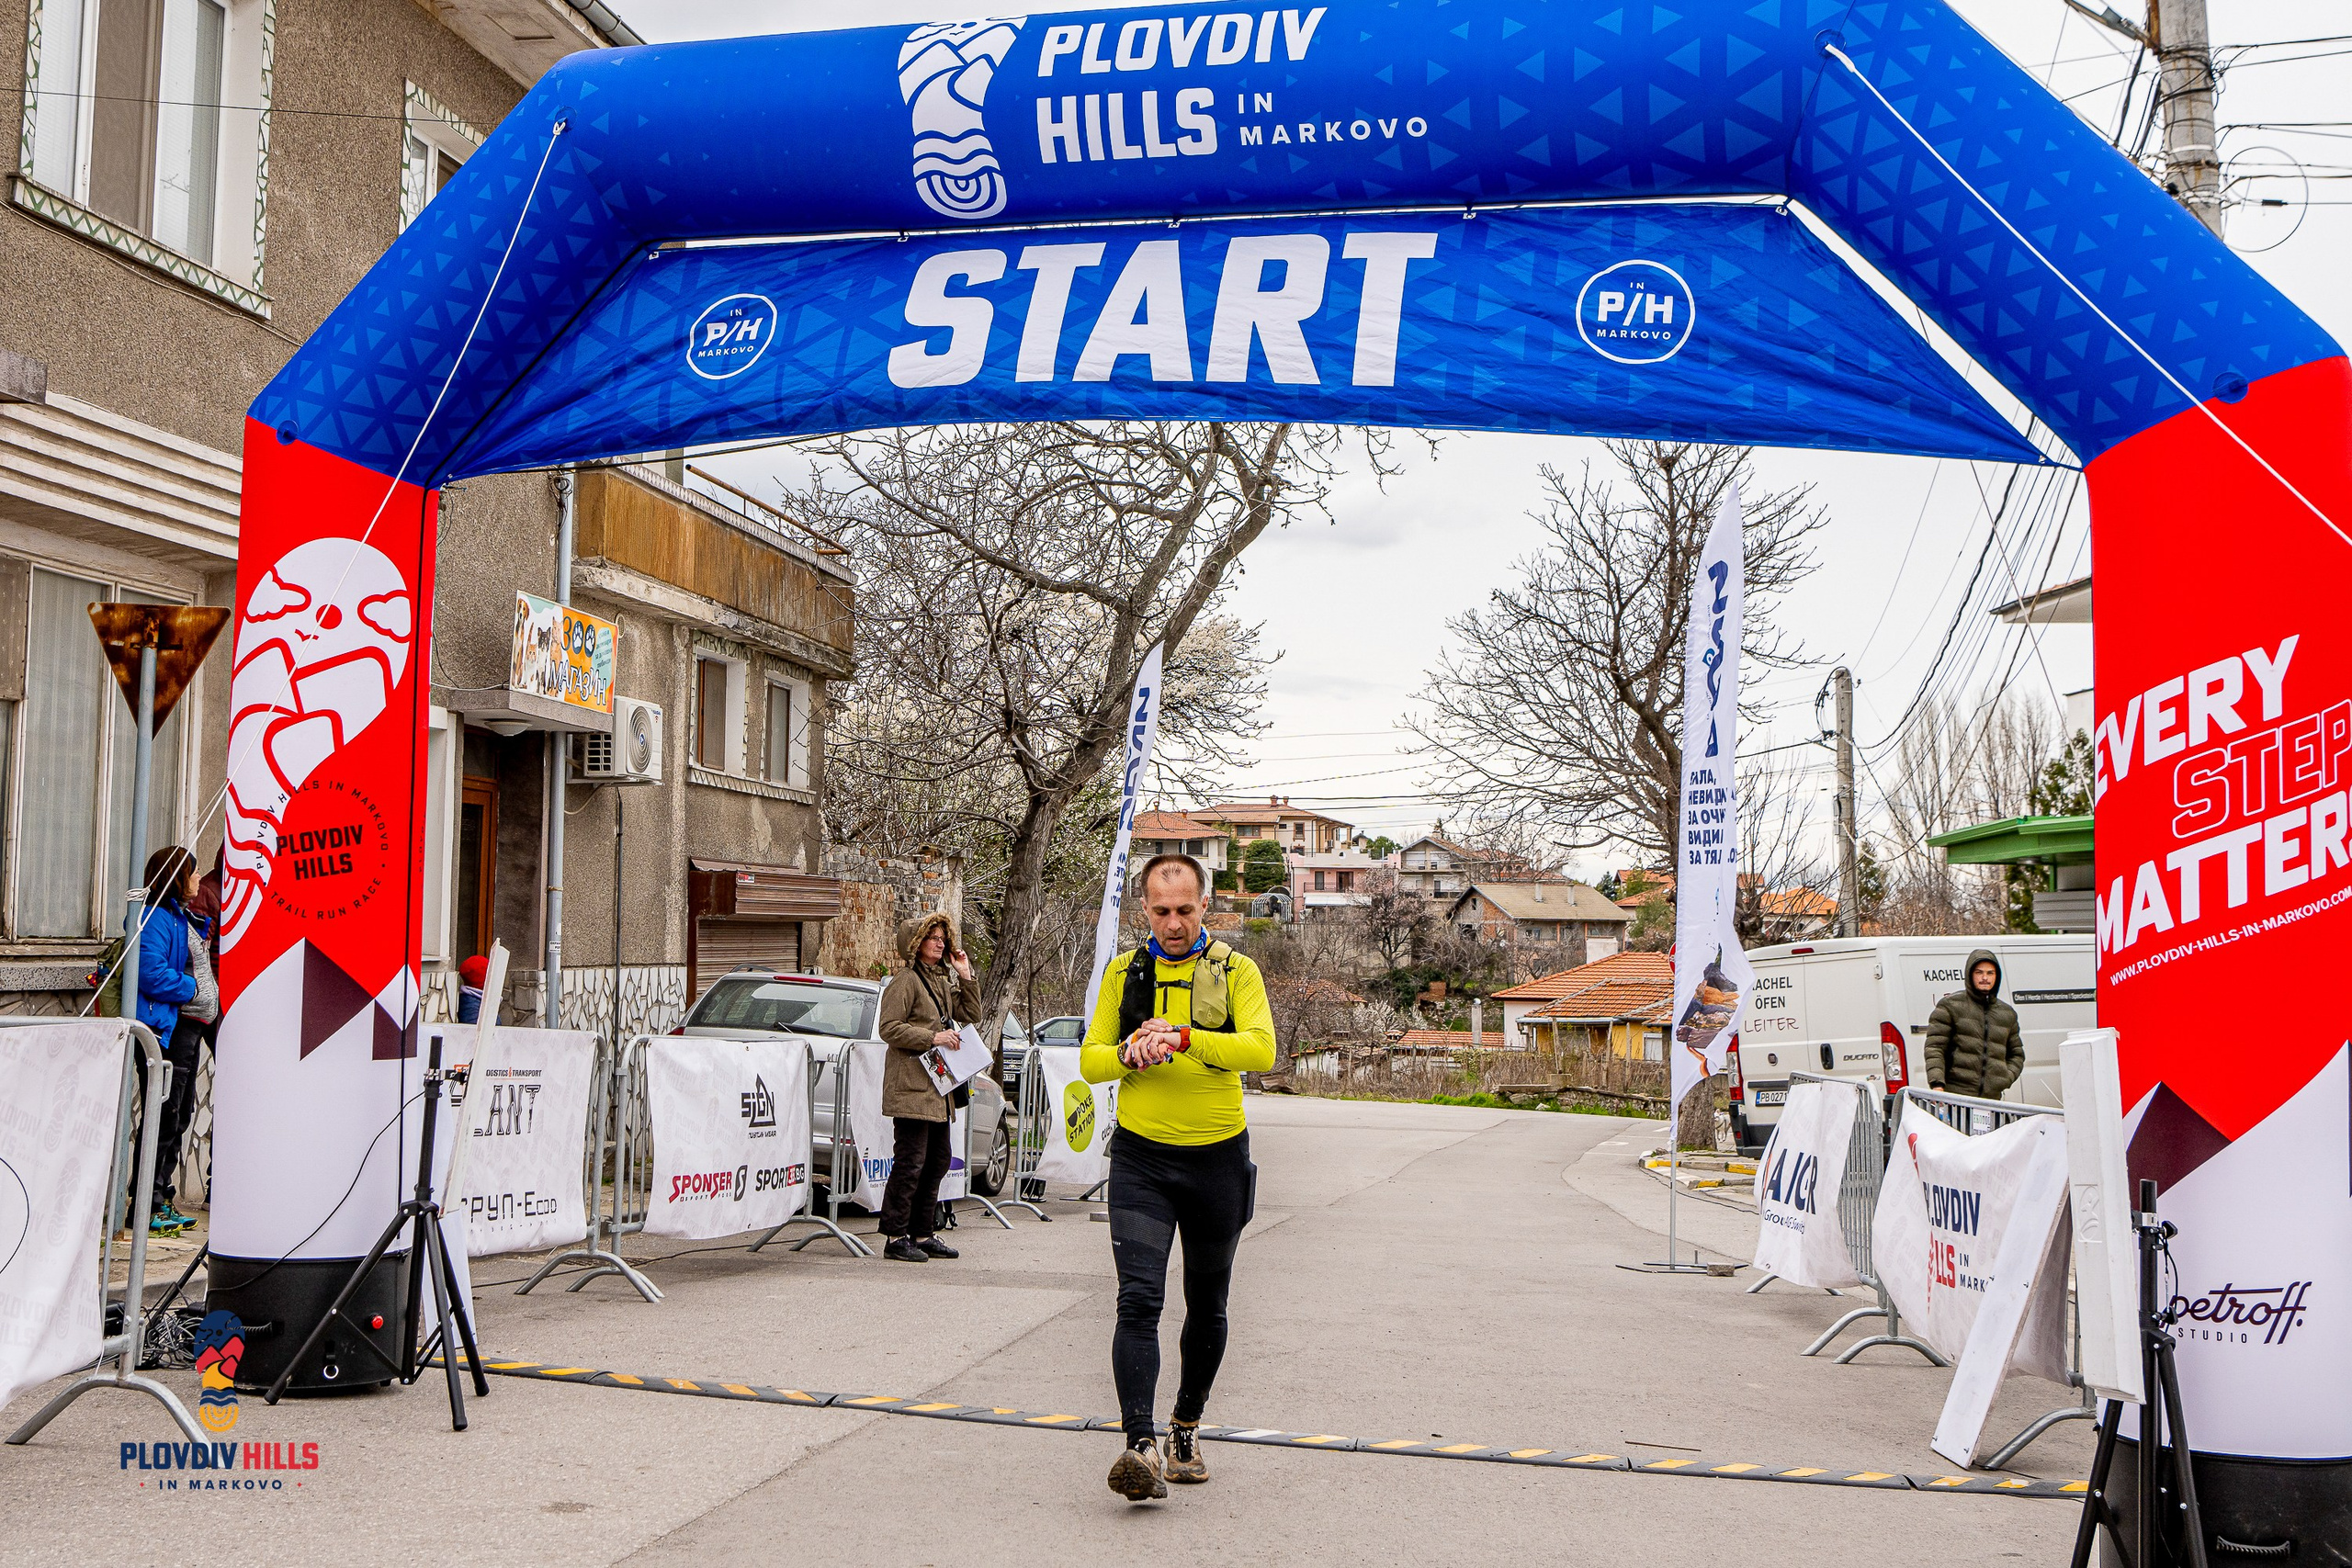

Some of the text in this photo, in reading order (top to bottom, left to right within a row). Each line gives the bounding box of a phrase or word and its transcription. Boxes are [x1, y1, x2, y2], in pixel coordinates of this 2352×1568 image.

[1037, 6, 1329, 77] PLOVDIV
[1238, 92, 1273, 115] IN
[1036, 87, 1218, 164] HILLS
[1239, 117, 1428, 146] MARKOVO
[1630, 281, 1645, 290] IN
[729, 308, 742, 317] IN
[887, 231, 1439, 389] START
[1597, 290, 1674, 326] P/H
[702, 317, 763, 347] P/H
[1596, 329, 1672, 340] MARKOVO
[697, 345, 754, 357] MARKOVO
[548, 659, 607, 706] МАГАЗИН
[2095, 633, 2301, 807] EVERY
[2172, 698, 2352, 840] STEP
[256, 781, 389, 870] PLOVDIV HILLS IN MARKOVO
[1688, 810, 1699, 825] ЗА
[276, 824, 363, 857] PLOVDIV
[293, 852, 354, 881] HILLS
[1689, 850, 1702, 864] ЗА
[2096, 784, 2352, 972] MATTER
[270, 877, 381, 920] TRAIL RUN RACE
[2110, 885, 2352, 987] WWW.PLOVDIV-HILLS-IN-MARKOVO.COM
[1752, 976, 1793, 991] ACHEL
[1923, 968, 1965, 982] KACHEL
[1755, 994, 1786, 1010] ÖFEN
[1744, 1017, 1800, 1033] LEITER
[1843, 1053, 1880, 1061] DUCATO
[512, 1069, 542, 1077] TRANSPORT
[1076, 1093, 1093, 1117] POKE
[1069, 1108, 1095, 1144] STATION
[668, 1171, 732, 1204] SPONSER
[1764, 1209, 1784, 1225] Grou
[1959, 1252, 1970, 1268] IN
[1960, 1273, 1988, 1292] MARK
[2177, 1326, 2248, 1344] STUDIO
